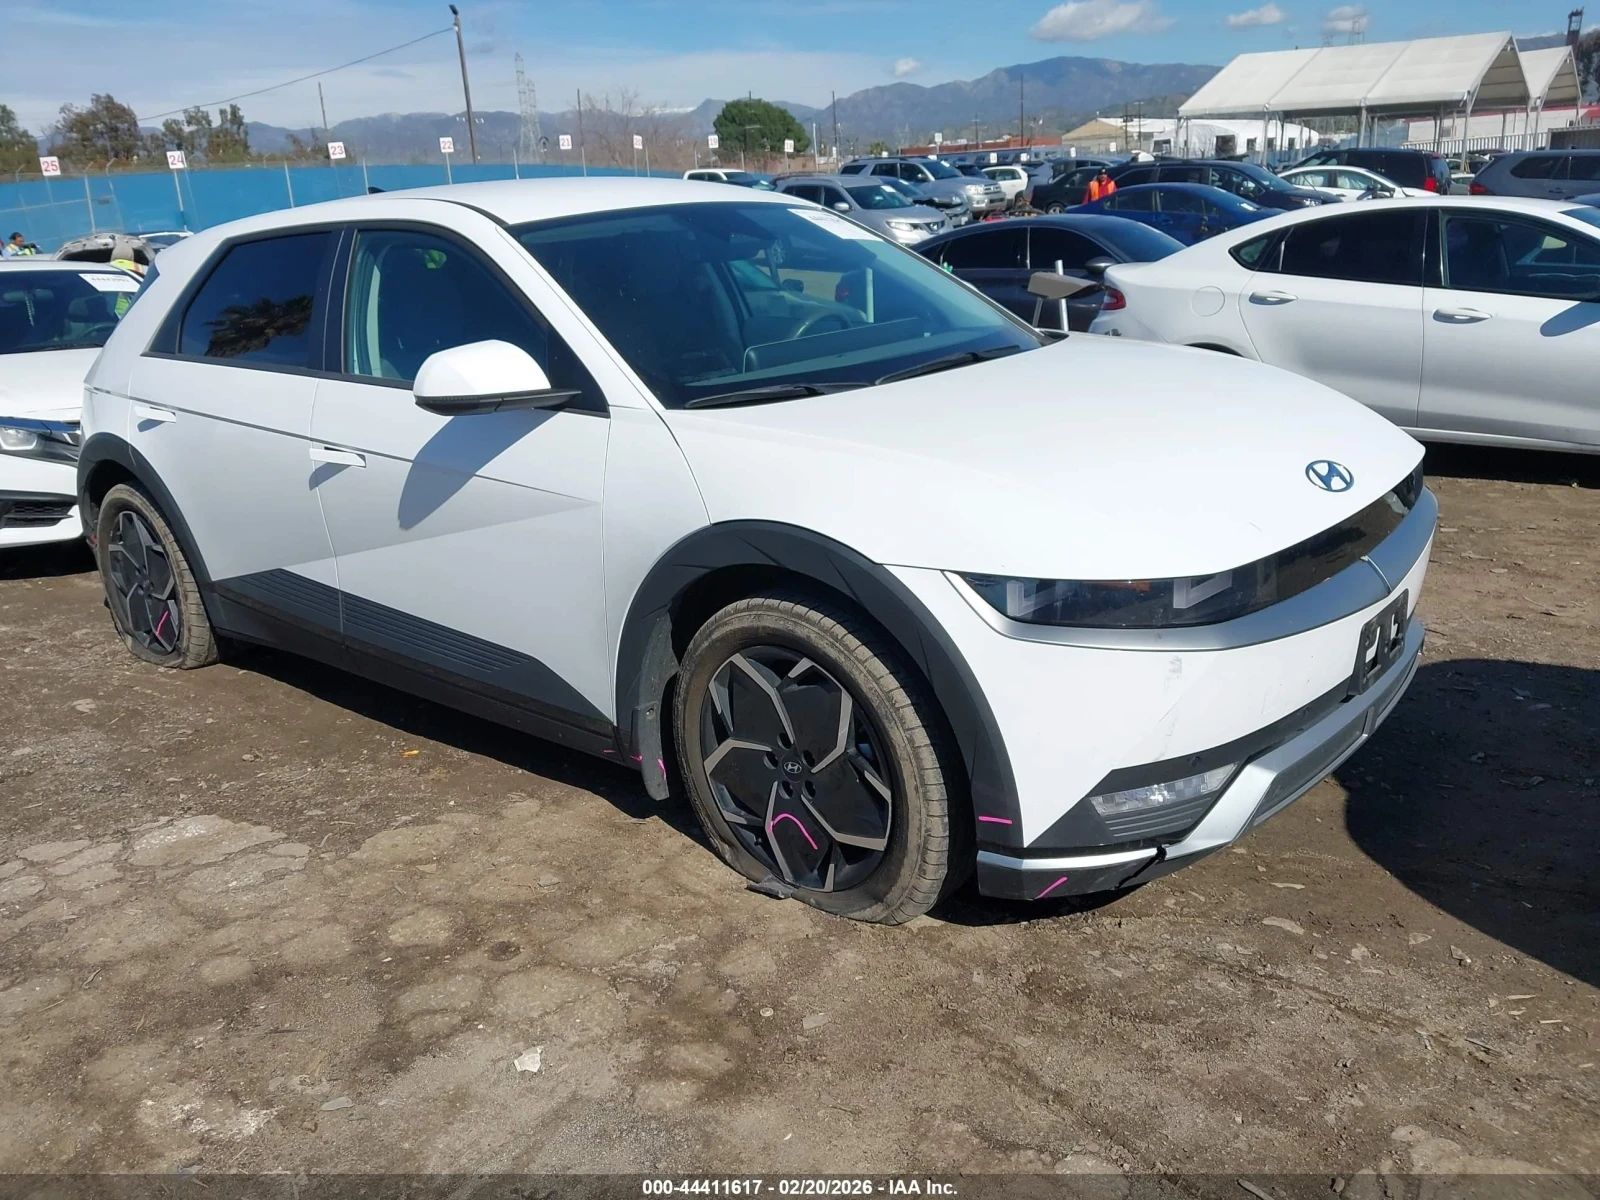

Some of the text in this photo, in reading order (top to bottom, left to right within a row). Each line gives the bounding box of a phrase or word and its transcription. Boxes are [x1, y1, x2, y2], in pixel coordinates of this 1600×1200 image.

[441, 140, 453, 150] 22
[560, 137, 570, 147] 21
[330, 145, 344, 155] 23
[169, 154, 184, 166] 24
[42, 160, 58, 172] 25
